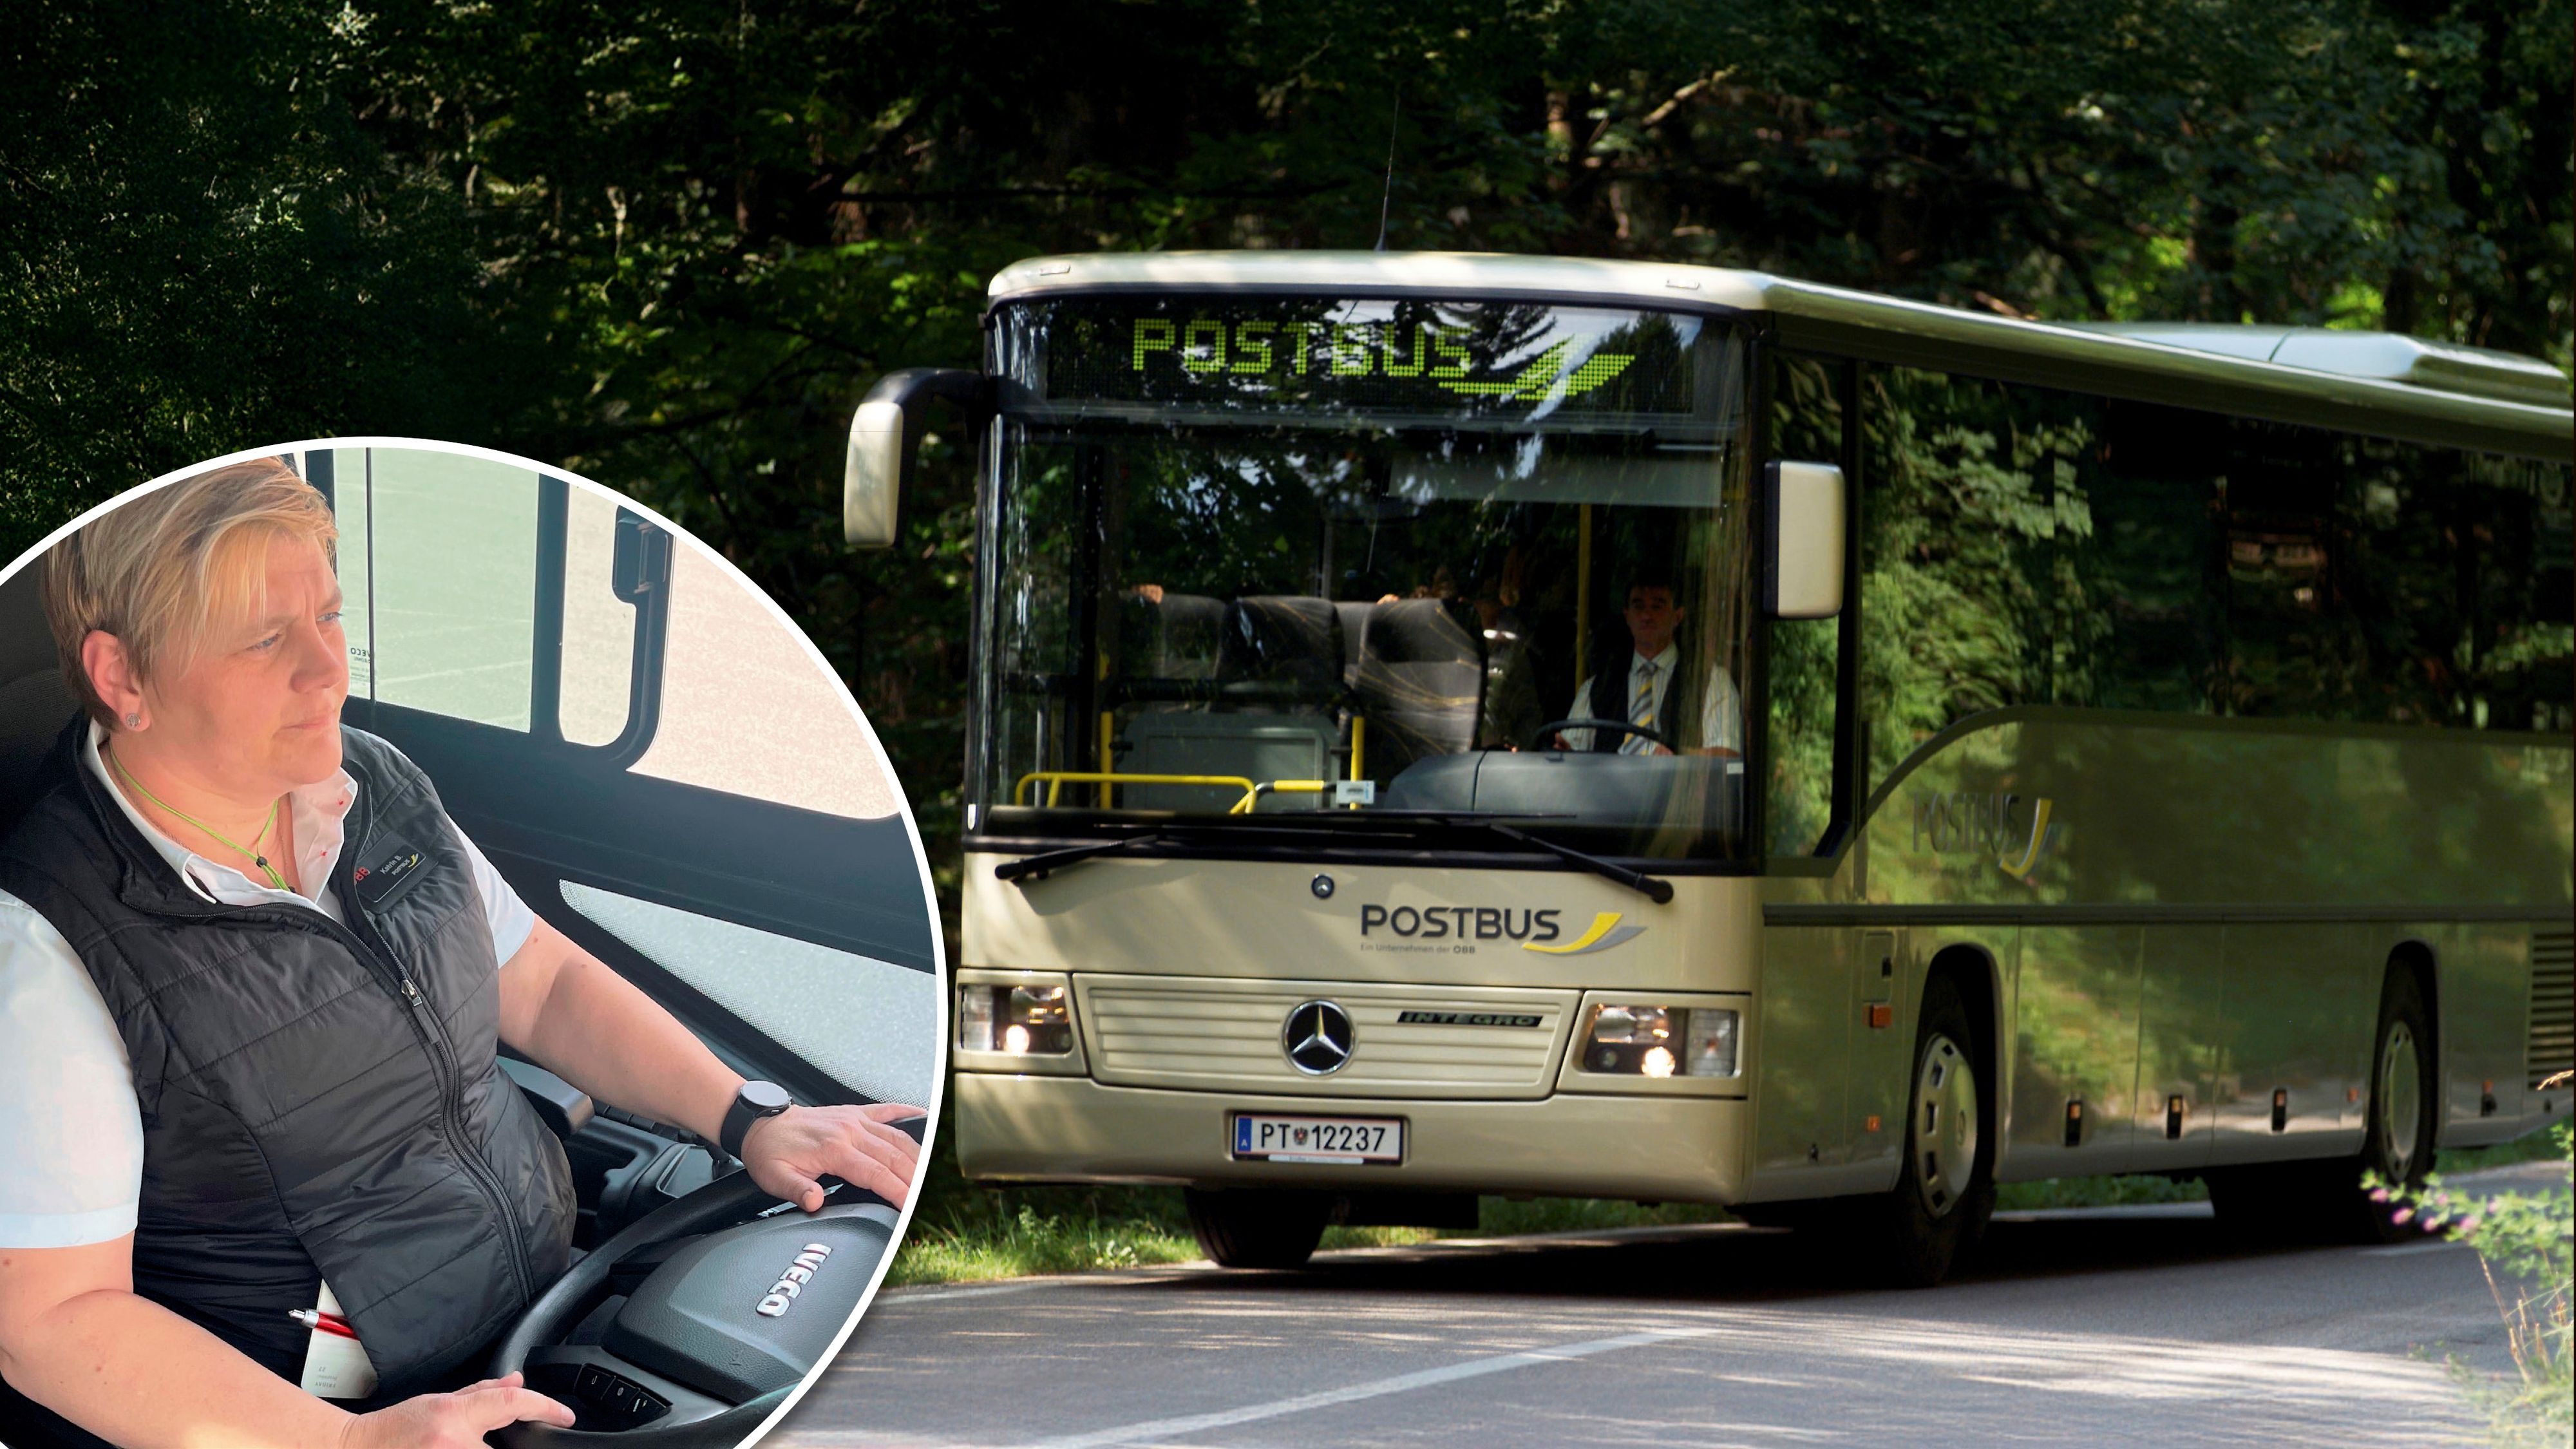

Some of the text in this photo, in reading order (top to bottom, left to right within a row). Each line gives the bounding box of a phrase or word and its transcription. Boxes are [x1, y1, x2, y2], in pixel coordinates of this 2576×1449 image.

[1133, 319, 1478, 378] POSTBUS
[354, 866, 370, 882] BB
[380, 859, 397, 874] Katrin
[1361, 904, 1562, 941] POSTBUS
[1403, 1012, 1537, 1027] INTEGRO
[1260, 1123, 1291, 1148] PT
[1311, 1124, 1386, 1153] 12237
[755, 1243, 833, 1318] IVECO
